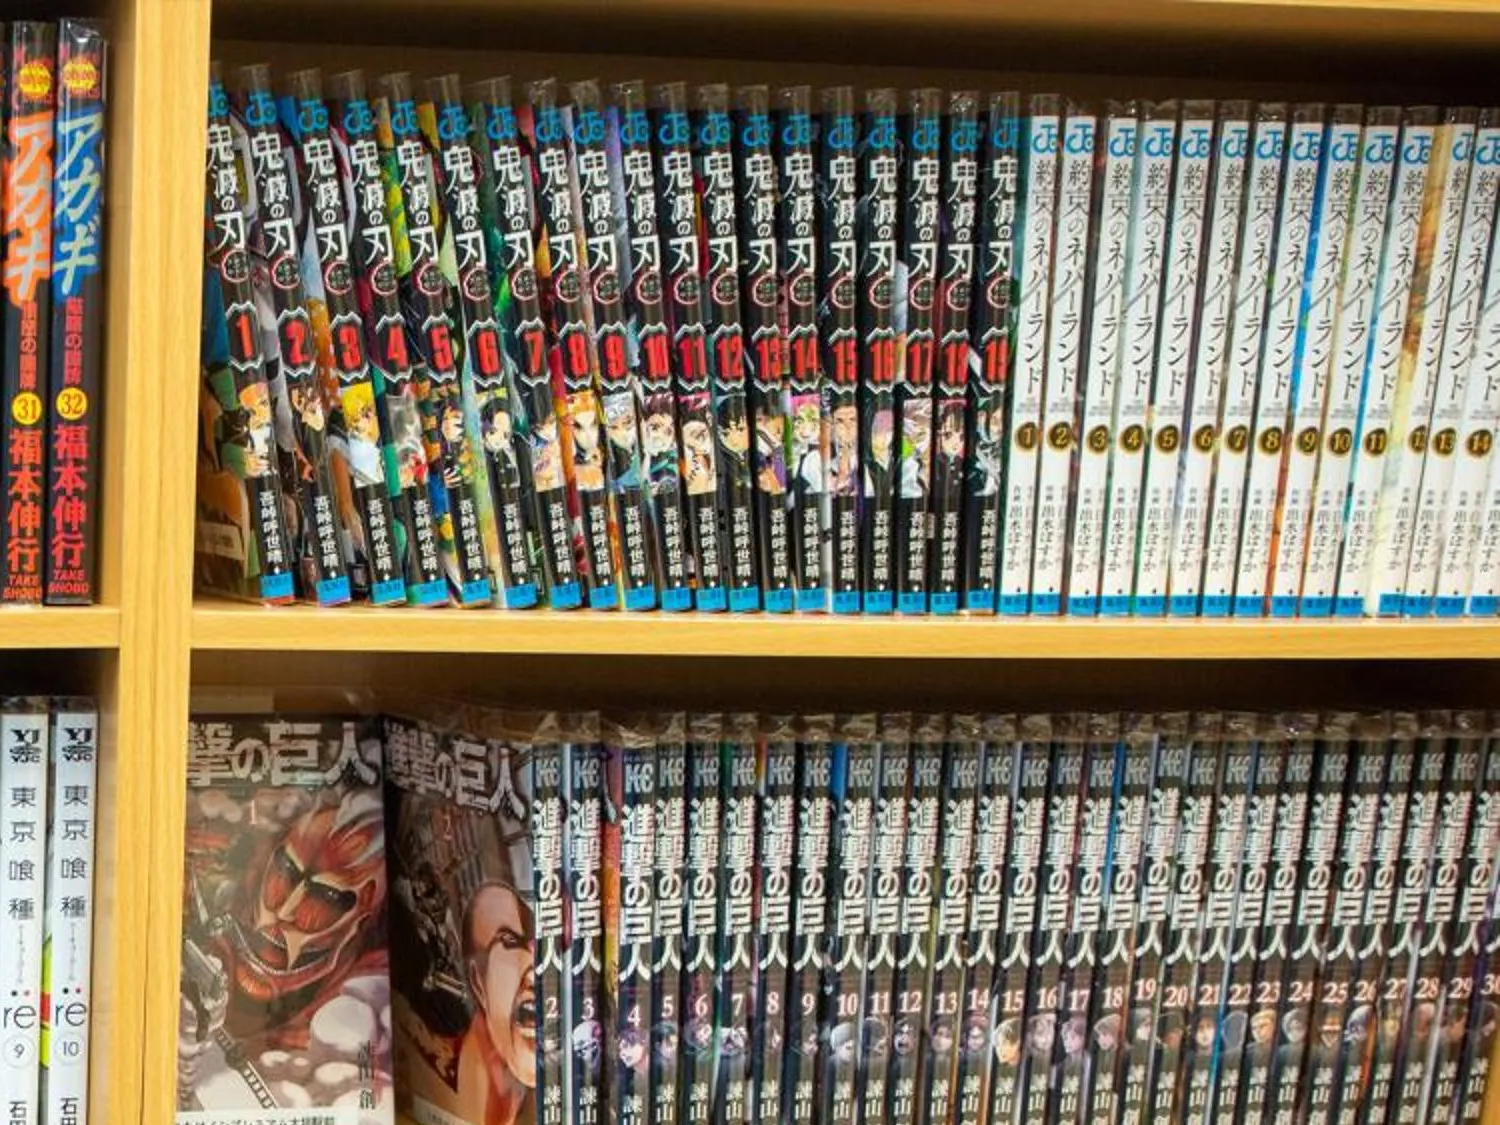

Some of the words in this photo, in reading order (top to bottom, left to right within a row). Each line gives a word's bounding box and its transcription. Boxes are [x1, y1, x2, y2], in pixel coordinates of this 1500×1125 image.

[54, 114, 100, 298] アカギ
[206, 126, 245, 248] 鬼滅の刃
[304, 139, 352, 262] 鬼滅の刃
[444, 145, 487, 267] 鬼滅の刃
[579, 151, 620, 271] 鬼滅の刃
[703, 151, 739, 272] 鬼滅の刃
[909, 157, 940, 278] 鬼滅の刃
[239, 315, 252, 356] 1
[340, 325, 361, 366] 3
[430, 323, 451, 364] 5
[526, 329, 545, 369] 7
[794, 339, 819, 381] 14
[909, 340, 933, 380] 17
[61, 393, 83, 413] 32
[1054, 426, 1069, 446] 2
[1160, 428, 1174, 447] 5
[1264, 430, 1280, 449] 8
[1332, 430, 1351, 451] 10
[53, 425, 90, 569] 福本伸行
[187, 720, 377, 787] 撃の巨人
[61, 785, 89, 919] 東京喰種
[533, 798, 563, 976] 進撃の巨人
[620, 804, 654, 981] 進撃の巨人
[688, 798, 720, 973] 進撃の巨人
[900, 796, 938, 970] 進撃の巨人
[1037, 795, 1076, 968] 進撃の巨人
[1327, 793, 1378, 962] 進撃の巨人
[547, 997, 559, 1018] 2
[731, 994, 744, 1016] 7
[900, 991, 922, 1013] 12
[1136, 977, 1157, 1000] 19
[1257, 981, 1281, 1003] 23
[1323, 982, 1348, 1003] 25
[628, 1004, 641, 1027] 4
[63, 1041, 79, 1058] 10
